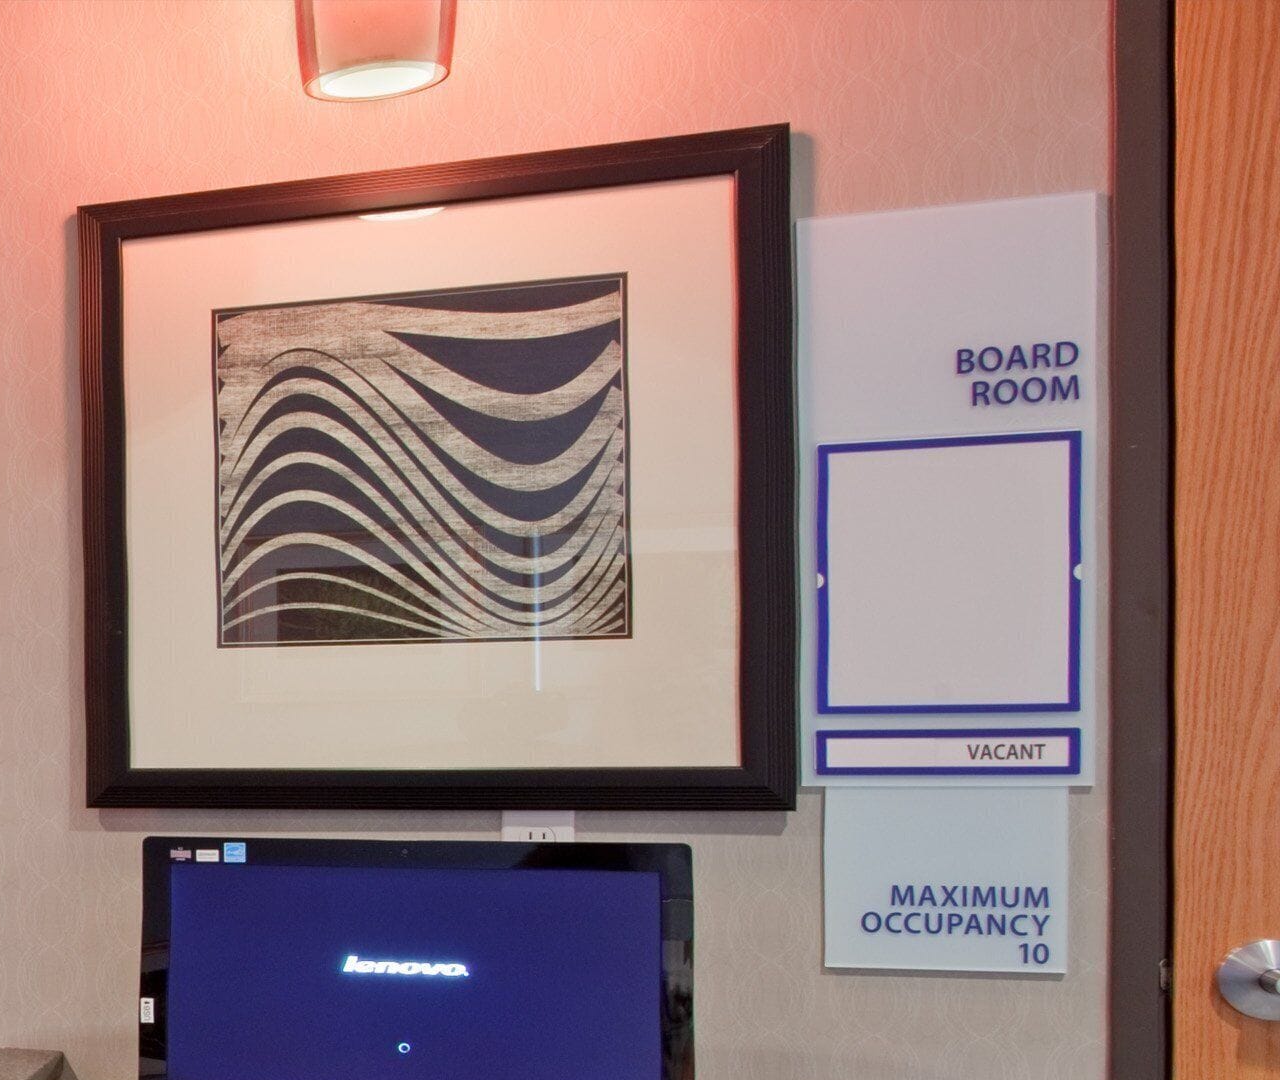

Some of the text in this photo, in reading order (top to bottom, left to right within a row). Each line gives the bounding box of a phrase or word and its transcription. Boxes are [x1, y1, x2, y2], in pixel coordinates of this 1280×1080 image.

[956, 341, 1079, 374] BOARD
[971, 374, 1080, 406] ROOM
[966, 744, 1046, 760] VACANT
[890, 885, 1049, 908] MAXIMUM
[860, 911, 1050, 936] OCCUPANCY
[1018, 943, 1050, 964] 10
